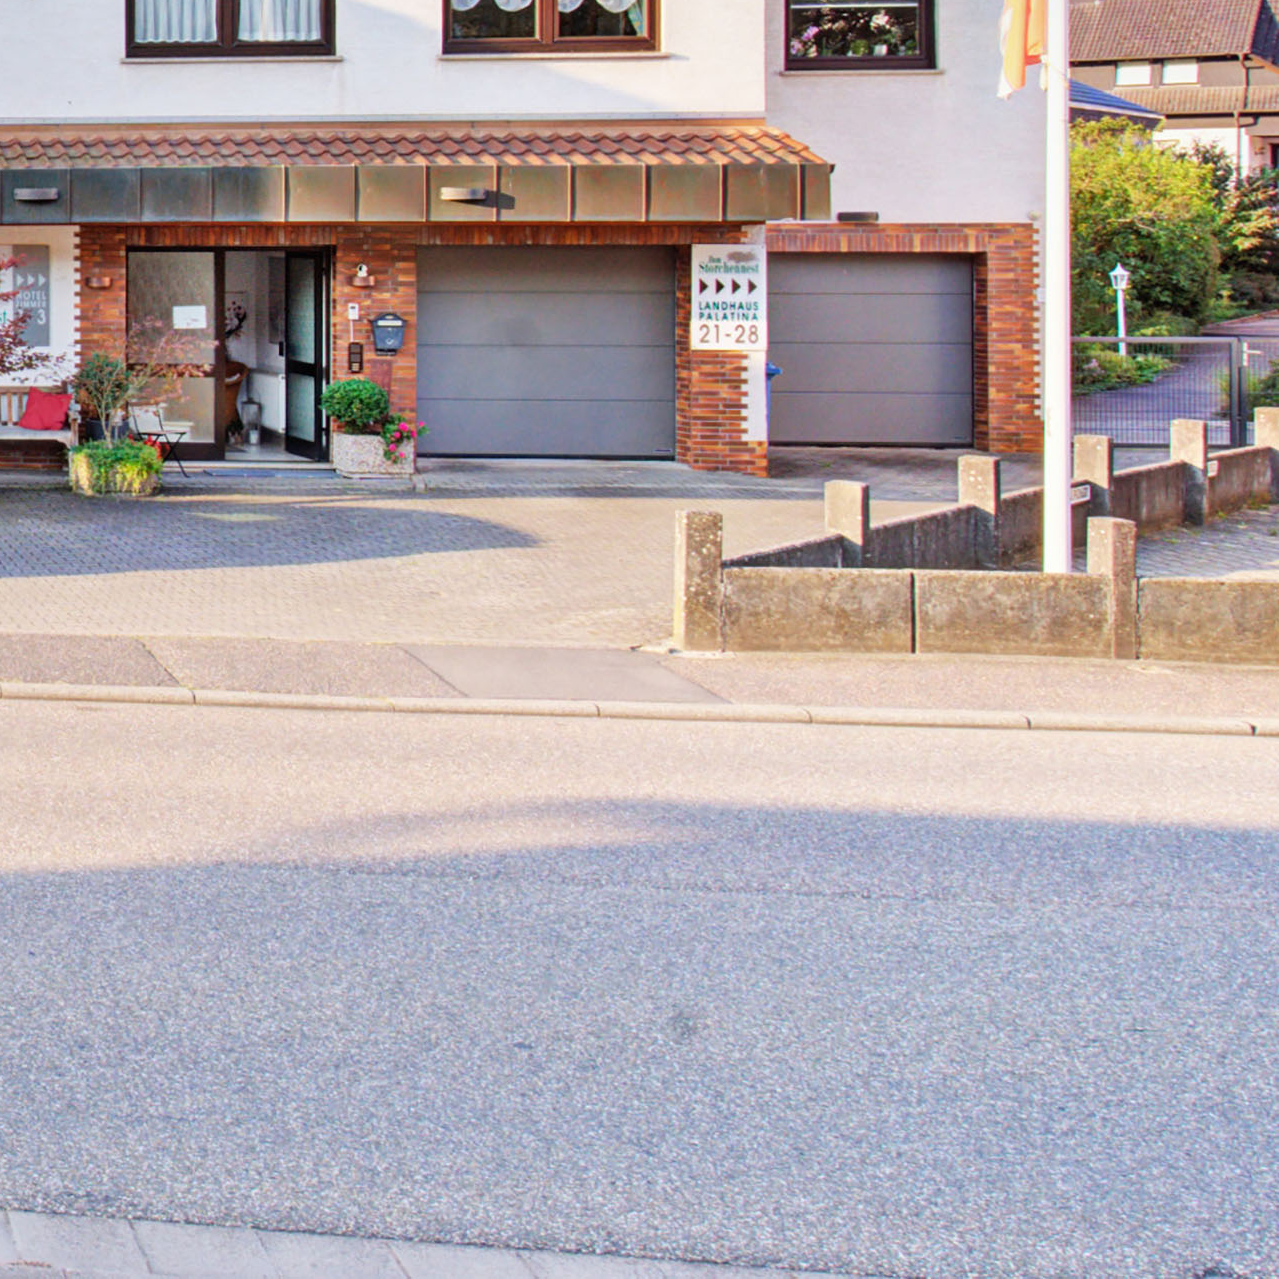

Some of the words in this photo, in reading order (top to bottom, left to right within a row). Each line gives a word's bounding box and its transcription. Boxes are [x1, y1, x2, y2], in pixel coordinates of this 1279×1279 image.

[698, 262, 759, 274] Storchennest
[698, 301, 759, 311] LANDHAUS
[698, 312, 759, 321] PALATINA
[699, 324, 759, 344] 21-28
